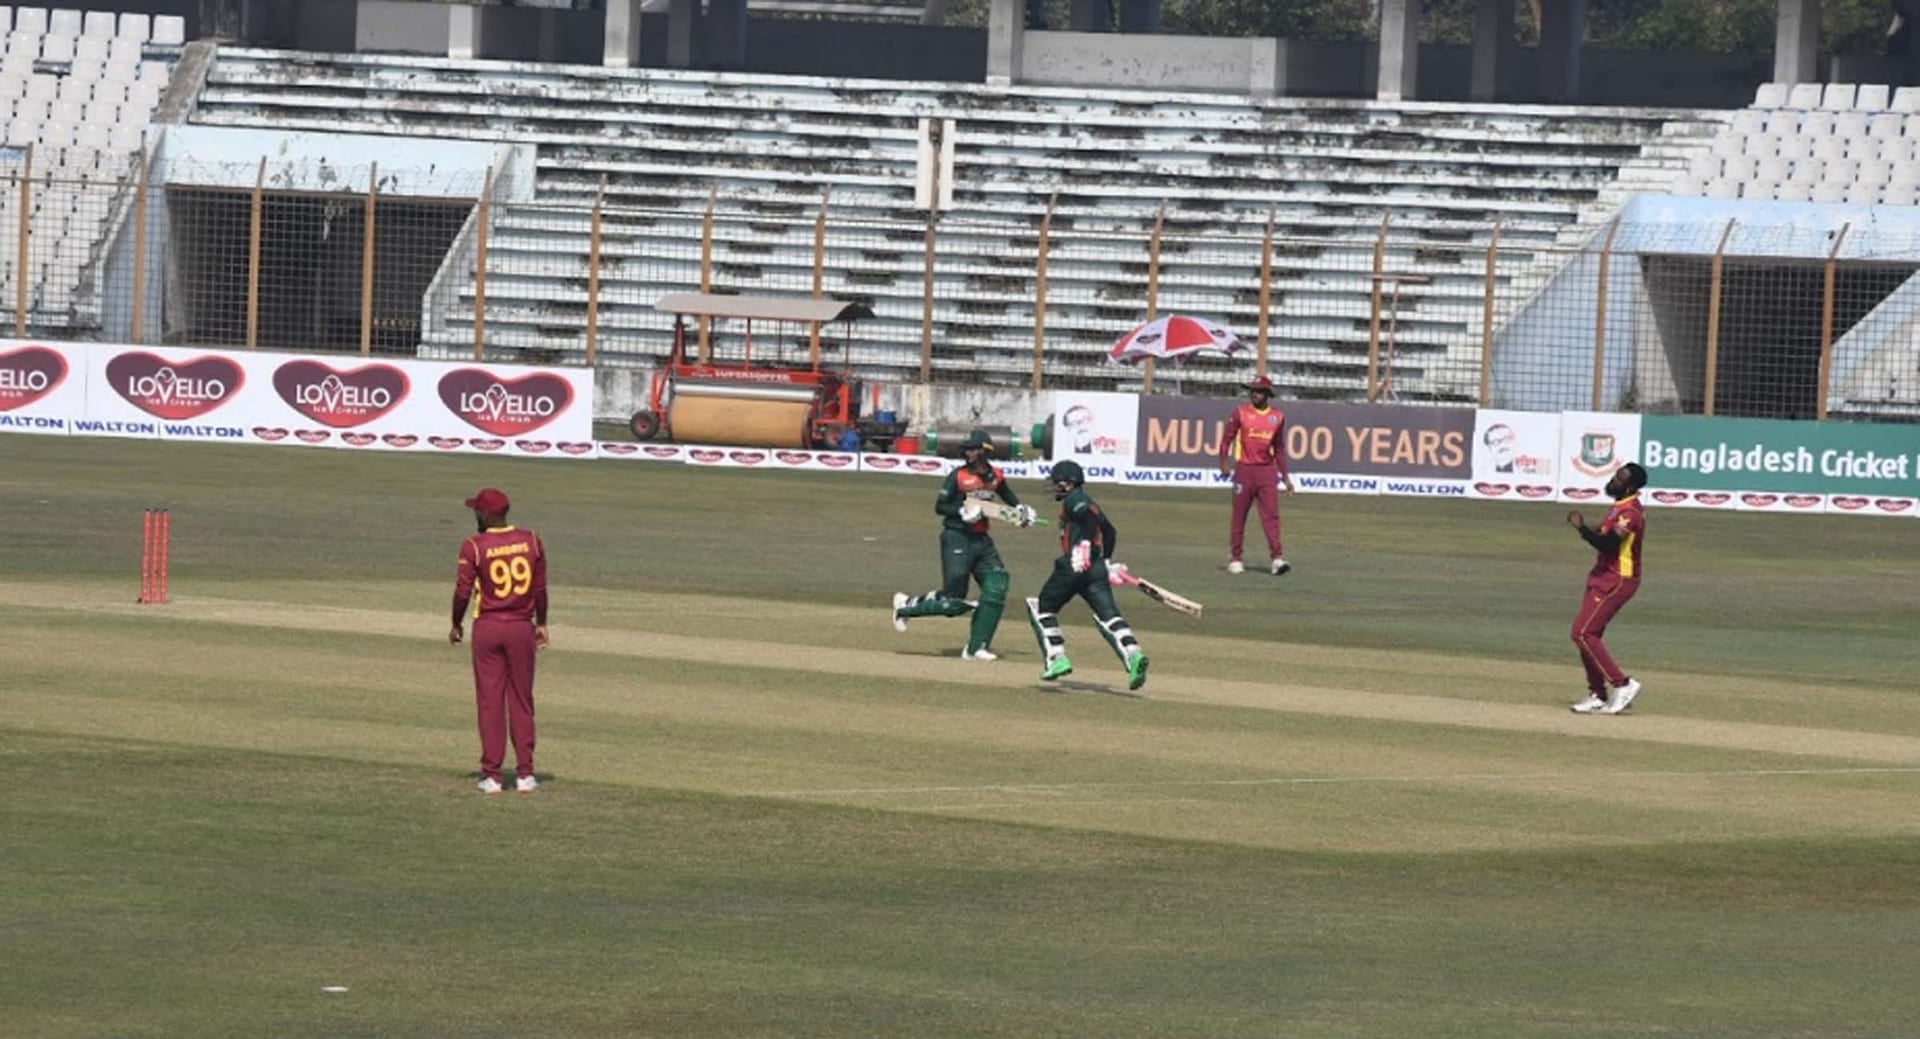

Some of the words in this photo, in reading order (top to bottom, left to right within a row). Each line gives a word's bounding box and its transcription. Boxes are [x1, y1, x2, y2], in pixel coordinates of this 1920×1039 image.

[129, 367, 225, 404] LOVELLO
[296, 375, 390, 413] LOVELLO
[461, 383, 555, 421] LOVELLO
[0, 415, 63, 428] ALTON
[75, 420, 154, 433] WALTON
[165, 424, 243, 437] WALTON
[1147, 417, 1229, 456] MUJ
[1282, 424, 1333, 462] 00
[1346, 427, 1465, 467] YEARS
[1645, 440, 1813, 473] Bangladesh
[1821, 449, 1908, 479] Cricket
[1125, 470, 1202, 482] WALTON
[1300, 477, 1377, 489] WALTON
[1387, 483, 1465, 495] WALTON
[490, 556, 532, 598] 99
